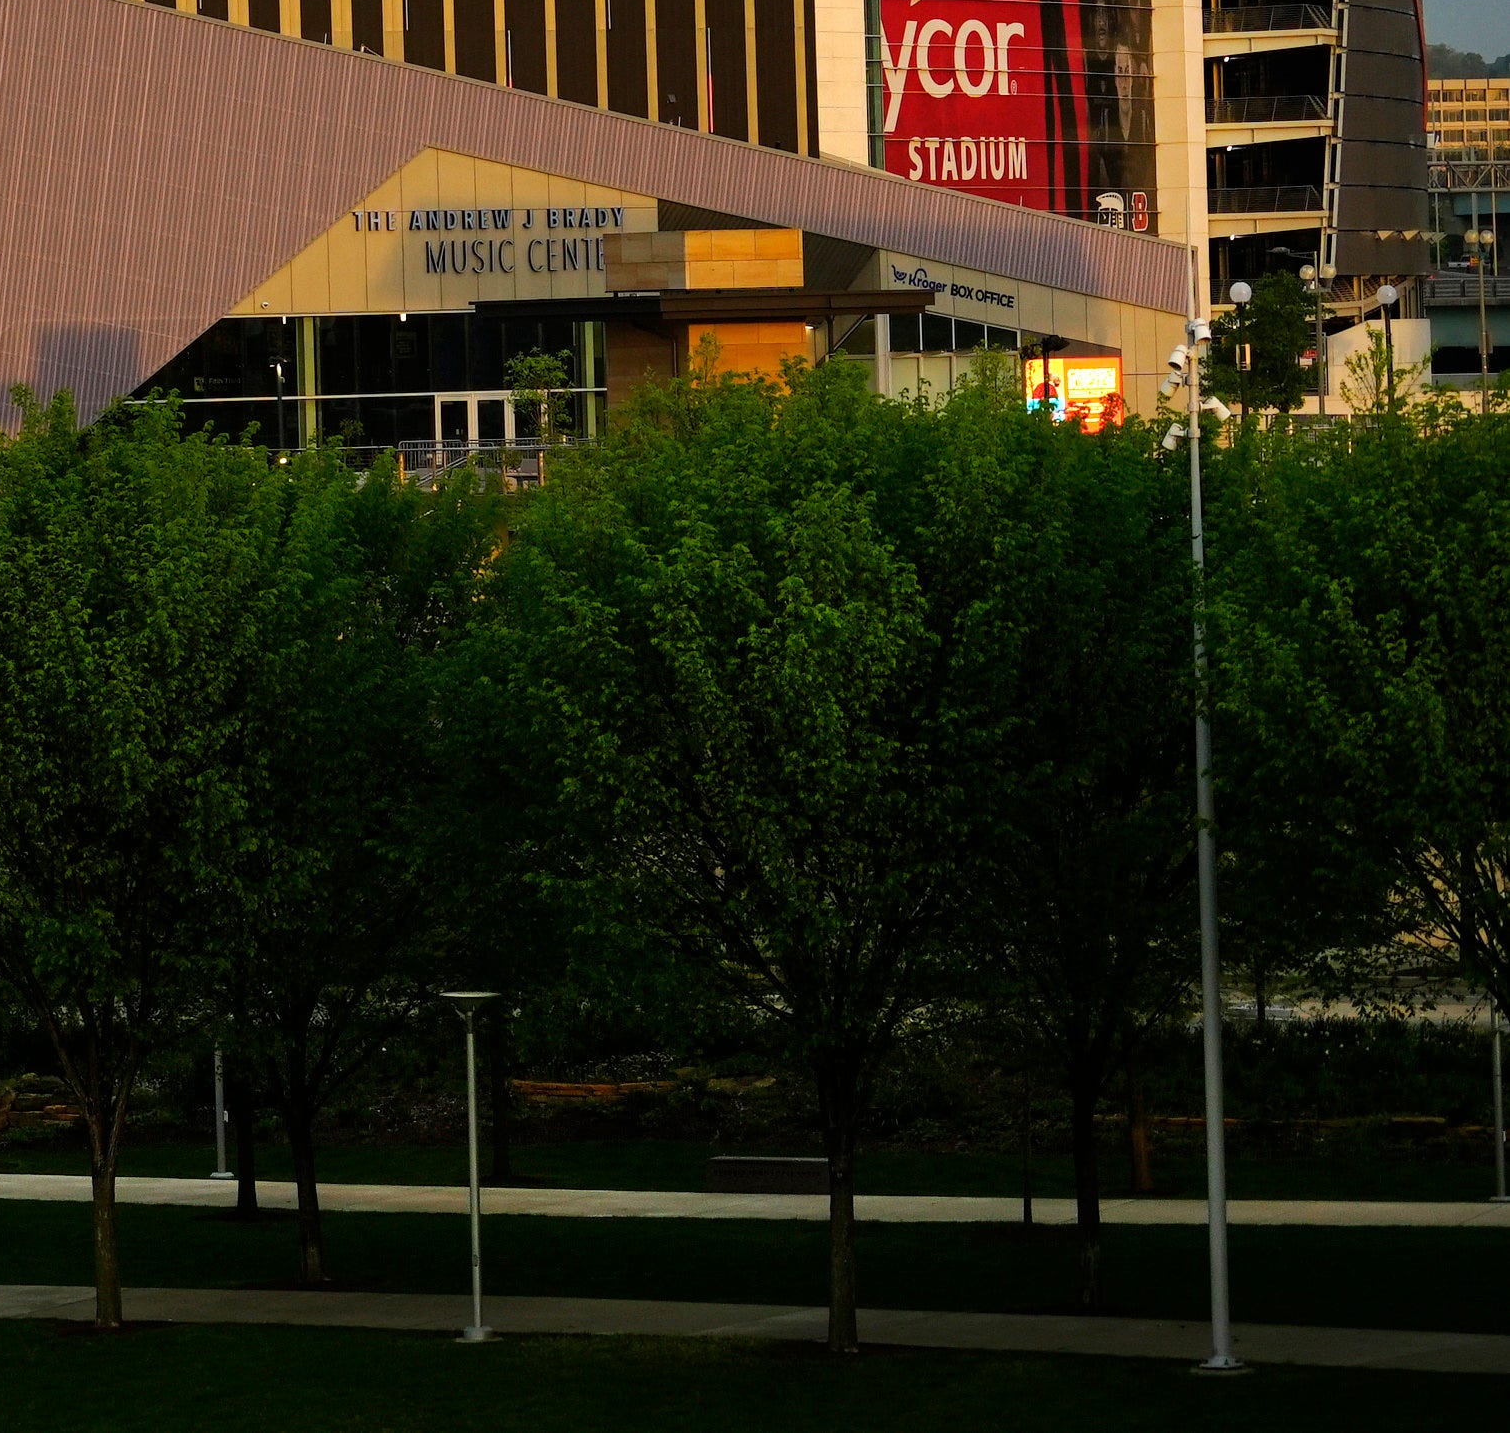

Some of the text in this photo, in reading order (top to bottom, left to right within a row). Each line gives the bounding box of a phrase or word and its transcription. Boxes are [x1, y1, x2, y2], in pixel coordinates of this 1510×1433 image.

[908, 136, 1028, 181] STADIUM
[352, 207, 625, 232] THE ANDREW J BRADY
[425, 239, 515, 275] MUSIC
[950, 283, 974, 301] BOX
[975, 288, 1015, 309] OFFICE
